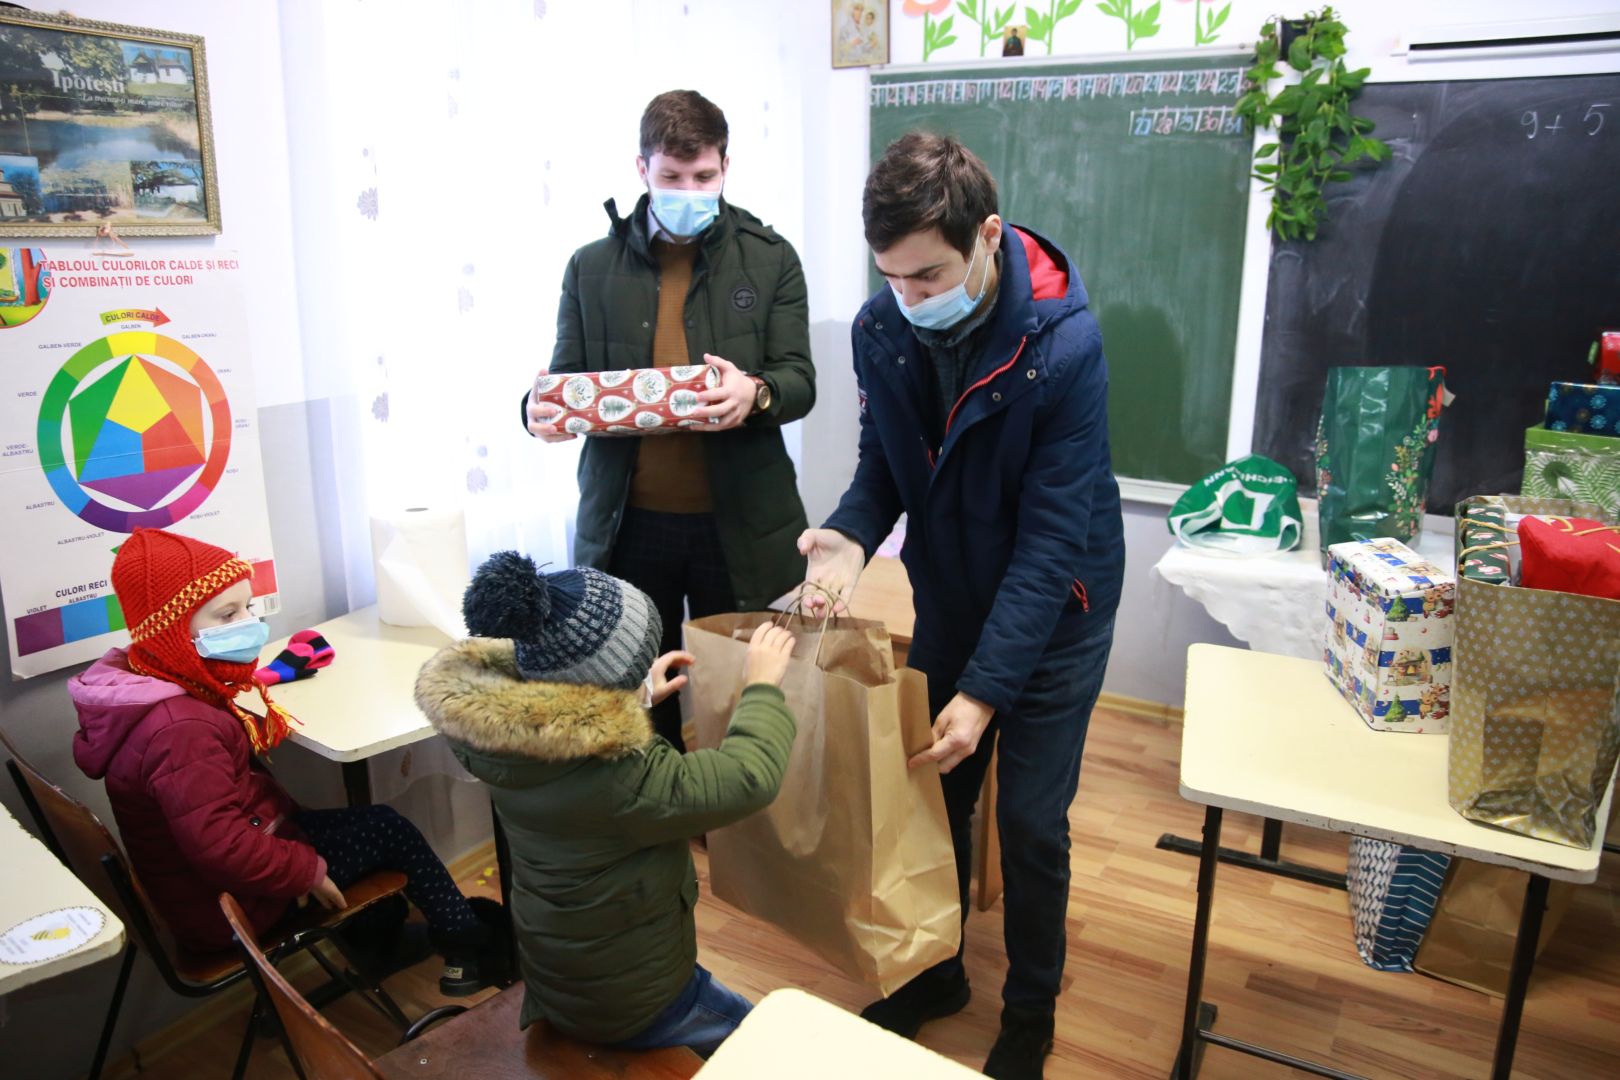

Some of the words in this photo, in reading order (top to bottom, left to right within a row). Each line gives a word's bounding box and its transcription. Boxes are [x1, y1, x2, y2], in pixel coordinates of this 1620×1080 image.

[999, 80, 1012, 99] 12
[1018, 79, 1031, 99] 13
[1033, 79, 1046, 98] 14
[1049, 78, 1062, 97] 15
[1065, 77, 1078, 96] 16
[1080, 76, 1093, 95] 17
[1096, 75, 1110, 95] 18
[1113, 75, 1124, 95] 19
[1126, 74, 1144, 94] 20
[1146, 74, 1160, 92] 21
[1161, 74, 1179, 92] 22
[1181, 73, 1199, 92] 23
[1200, 71, 1216, 92] 24
[1218, 73, 1239, 94] 25
[1134, 118, 1152, 136] 27
[1155, 117, 1173, 135] 28
[1180, 114, 1194, 132] 29
[1201, 116, 1219, 132] 30
[1224, 115, 1242, 134] 31
[40, 260, 99, 272] TABLOUL
[102, 259, 166, 272] CULORILOR
[168, 259, 203, 271] CALDE
[218, 260, 239, 271] RECI
[59, 276, 132, 290] COMBINAȚII
[136, 276, 150, 287] DE
[153, 275, 193, 286] CULORI
[105, 312, 134, 323] CULORI
[136, 312, 161, 322] CALDE
[38, 342, 82, 350] GALBEN-VERDE
[25, 501, 56, 510] ALBASTRU
[55, 583, 87, 599] CULORI
[89, 579, 108, 593] RECI
[26, 605, 48, 615] VIOLET
